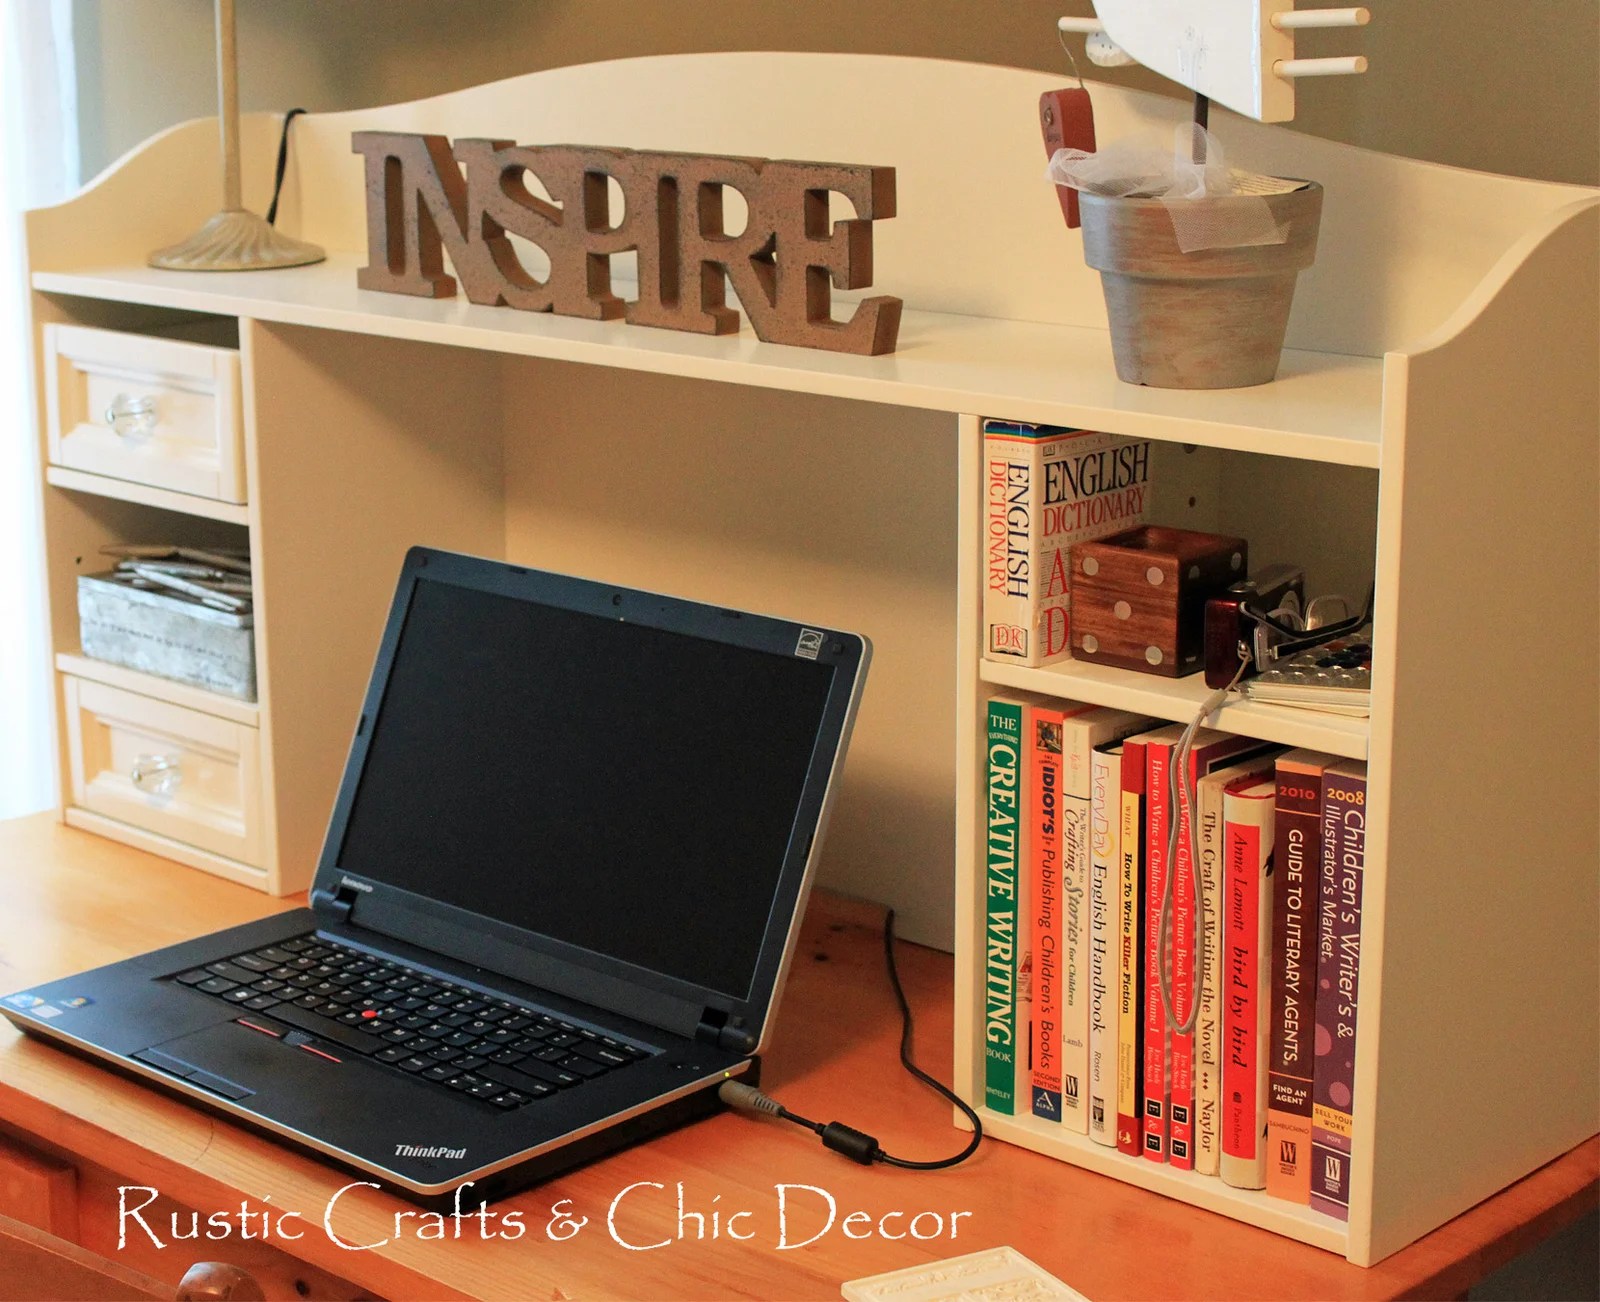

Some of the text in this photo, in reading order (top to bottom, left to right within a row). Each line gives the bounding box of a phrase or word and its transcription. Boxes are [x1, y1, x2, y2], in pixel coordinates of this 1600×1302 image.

[351, 130, 903, 356] INSPIRE
[1043, 442, 1150, 505] ENGLISH
[989, 461, 1007, 596] DICTIONARY
[1007, 461, 1030, 600] ENGLISH
[1043, 485, 1147, 537] DICTIONARY
[1046, 547, 1069, 599] A
[996, 625, 1023, 650] DK
[1044, 606, 1069, 658] D
[990, 714, 1017, 731] THE
[1152, 759, 1163, 788] How
[1152, 789, 1161, 801] to
[1279, 786, 1316, 800] 2010
[1327, 787, 1365, 806] 2008
[1042, 766, 1055, 835] IDIOT'S
[1152, 804, 1163, 836] Write
[1180, 804, 1191, 833] Write
[1064, 808, 1080, 872] Crafting
[1288, 829, 1304, 883] GUIDE
[1323, 804, 1341, 896] Illustrator's
[986, 744, 1017, 1046] CREATIVE WRITING
[1038, 849, 1056, 929] Publishing
[1092, 763, 1110, 1034] EveryDay English Handbook
[1151, 850, 1162, 905] Children's
[1177, 848, 1189, 904] Children's
[1233, 832, 1248, 931] Anne Lamott
[1287, 887, 1302, 910] TO
[1064, 876, 1085, 1007] Stories for Children
[1122, 852, 1133, 1014] How To Write Killer Fiction
[1151, 908, 1161, 948] Picture
[1177, 906, 1188, 945] Picture
[1201, 811, 1216, 1066] The Craft of Writing the Novel
[1337, 809, 1365, 1038] Children's Writer's &
[1041, 935, 1055, 1014] Children's
[1176, 949, 1188, 978] Book
[1285, 913, 1302, 994] LITERARY
[1150, 982, 1161, 1025] Volume
[1176, 981, 1188, 1024] Volume
[1230, 946, 1249, 1068] bird by bird
[986, 1047, 1012, 1064] BOOK
[1040, 1020, 1054, 1069] Books
[1062, 1035, 1083, 1048] Lamb
[1033, 1070, 1061, 1083] SECOND
[1033, 1078, 1060, 1091] EDITION
[1092, 1051, 1102, 1082] Rosen
[1273, 1083, 1307, 1098] FIND AN
[1035, 1102, 1055, 1112] ALPHA
[1275, 1093, 1304, 1106] AGENT
[1314, 1107, 1331, 1119] SELL
[1199, 1099, 1215, 1153] Naylor
[1323, 1119, 1345, 1132] WORK
[394, 1144, 467, 1159] ThinkPad
